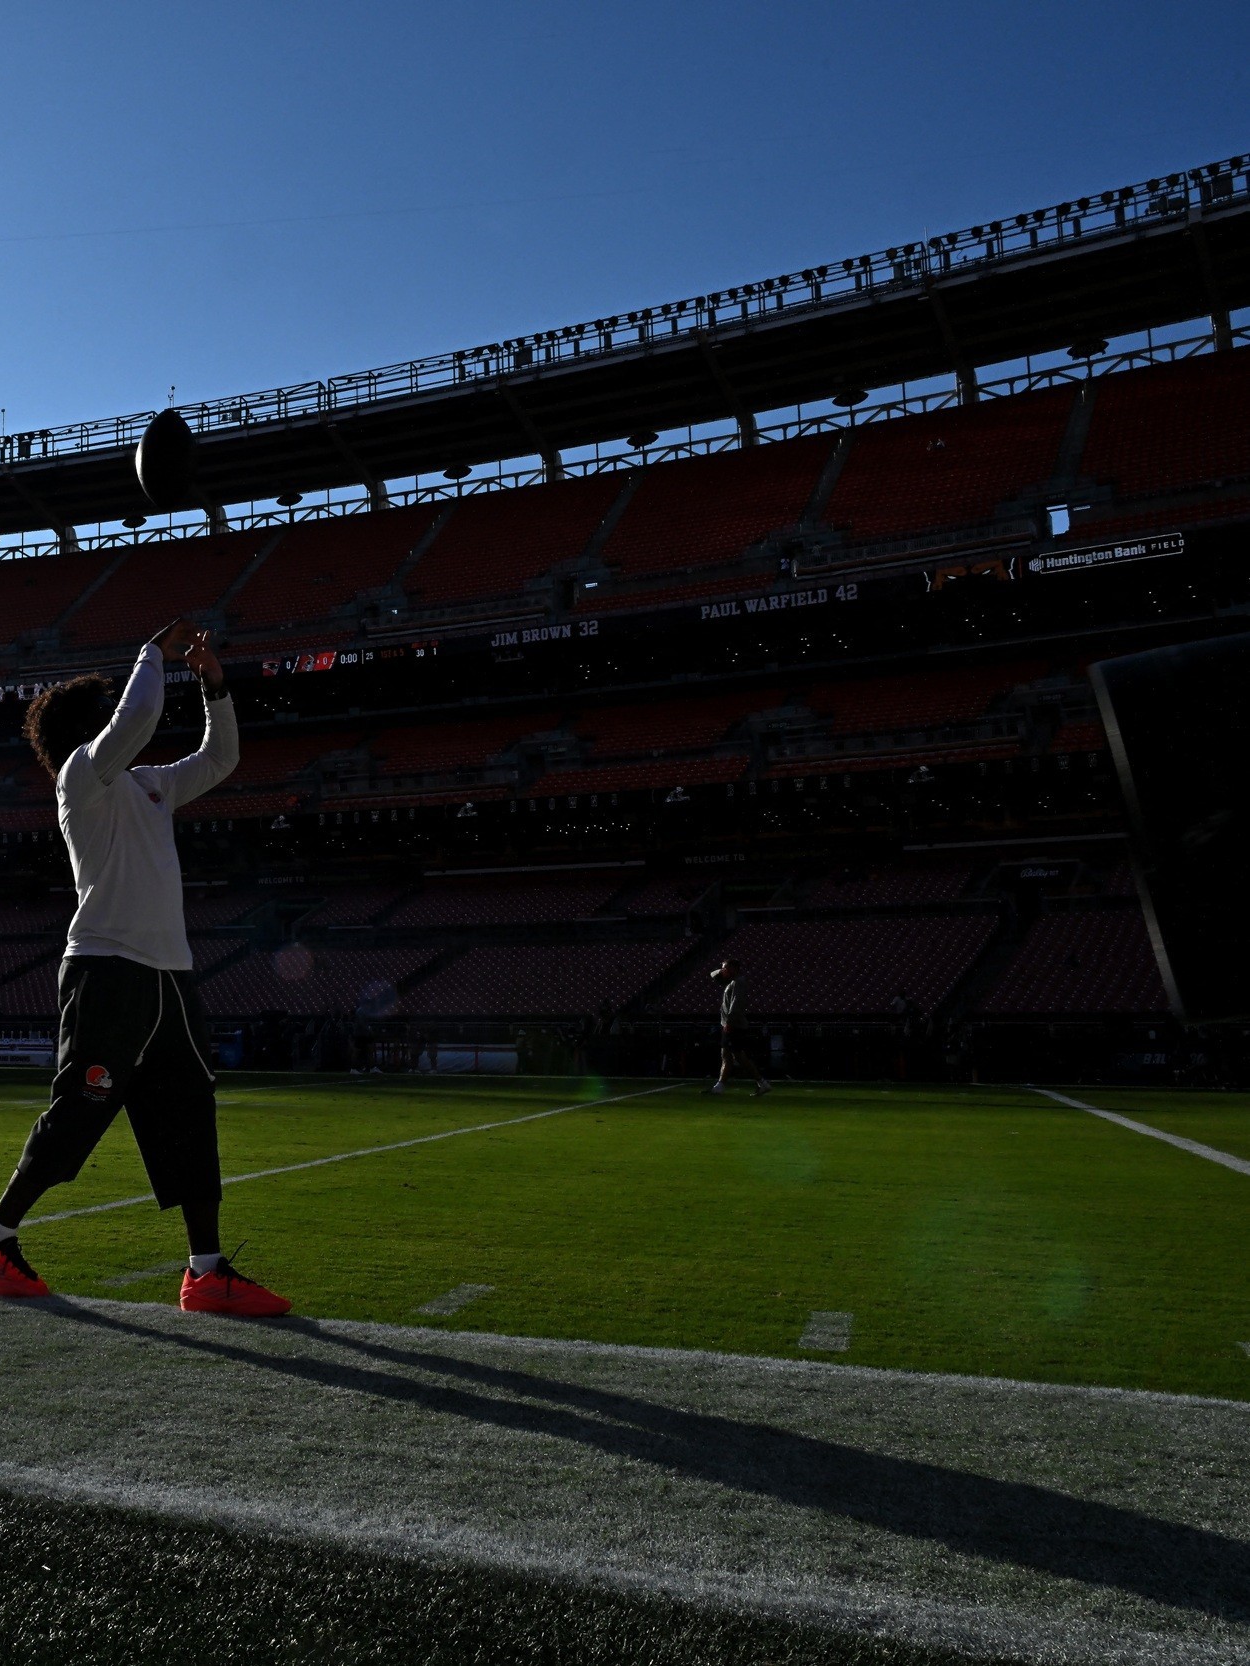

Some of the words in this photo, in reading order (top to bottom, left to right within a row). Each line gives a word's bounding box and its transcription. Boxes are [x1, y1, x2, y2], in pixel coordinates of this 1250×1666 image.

[1046, 550, 1112, 569] Huntington
[1114, 544, 1146, 559] Bank
[1151, 538, 1185, 551] FIELD
[701, 602, 741, 620] PAUL
[744, 589, 828, 613] WARFIELD
[835, 584, 858, 602] 42
[491, 631, 518, 647] JIM
[522, 624, 571, 644] BROWN
[579, 620, 599, 637] 32
[286, 661, 291, 670] 0
[340, 653, 358, 664] 0:00
[684, 854, 730, 864] WELCOME
[733, 853, 745, 861] TO
